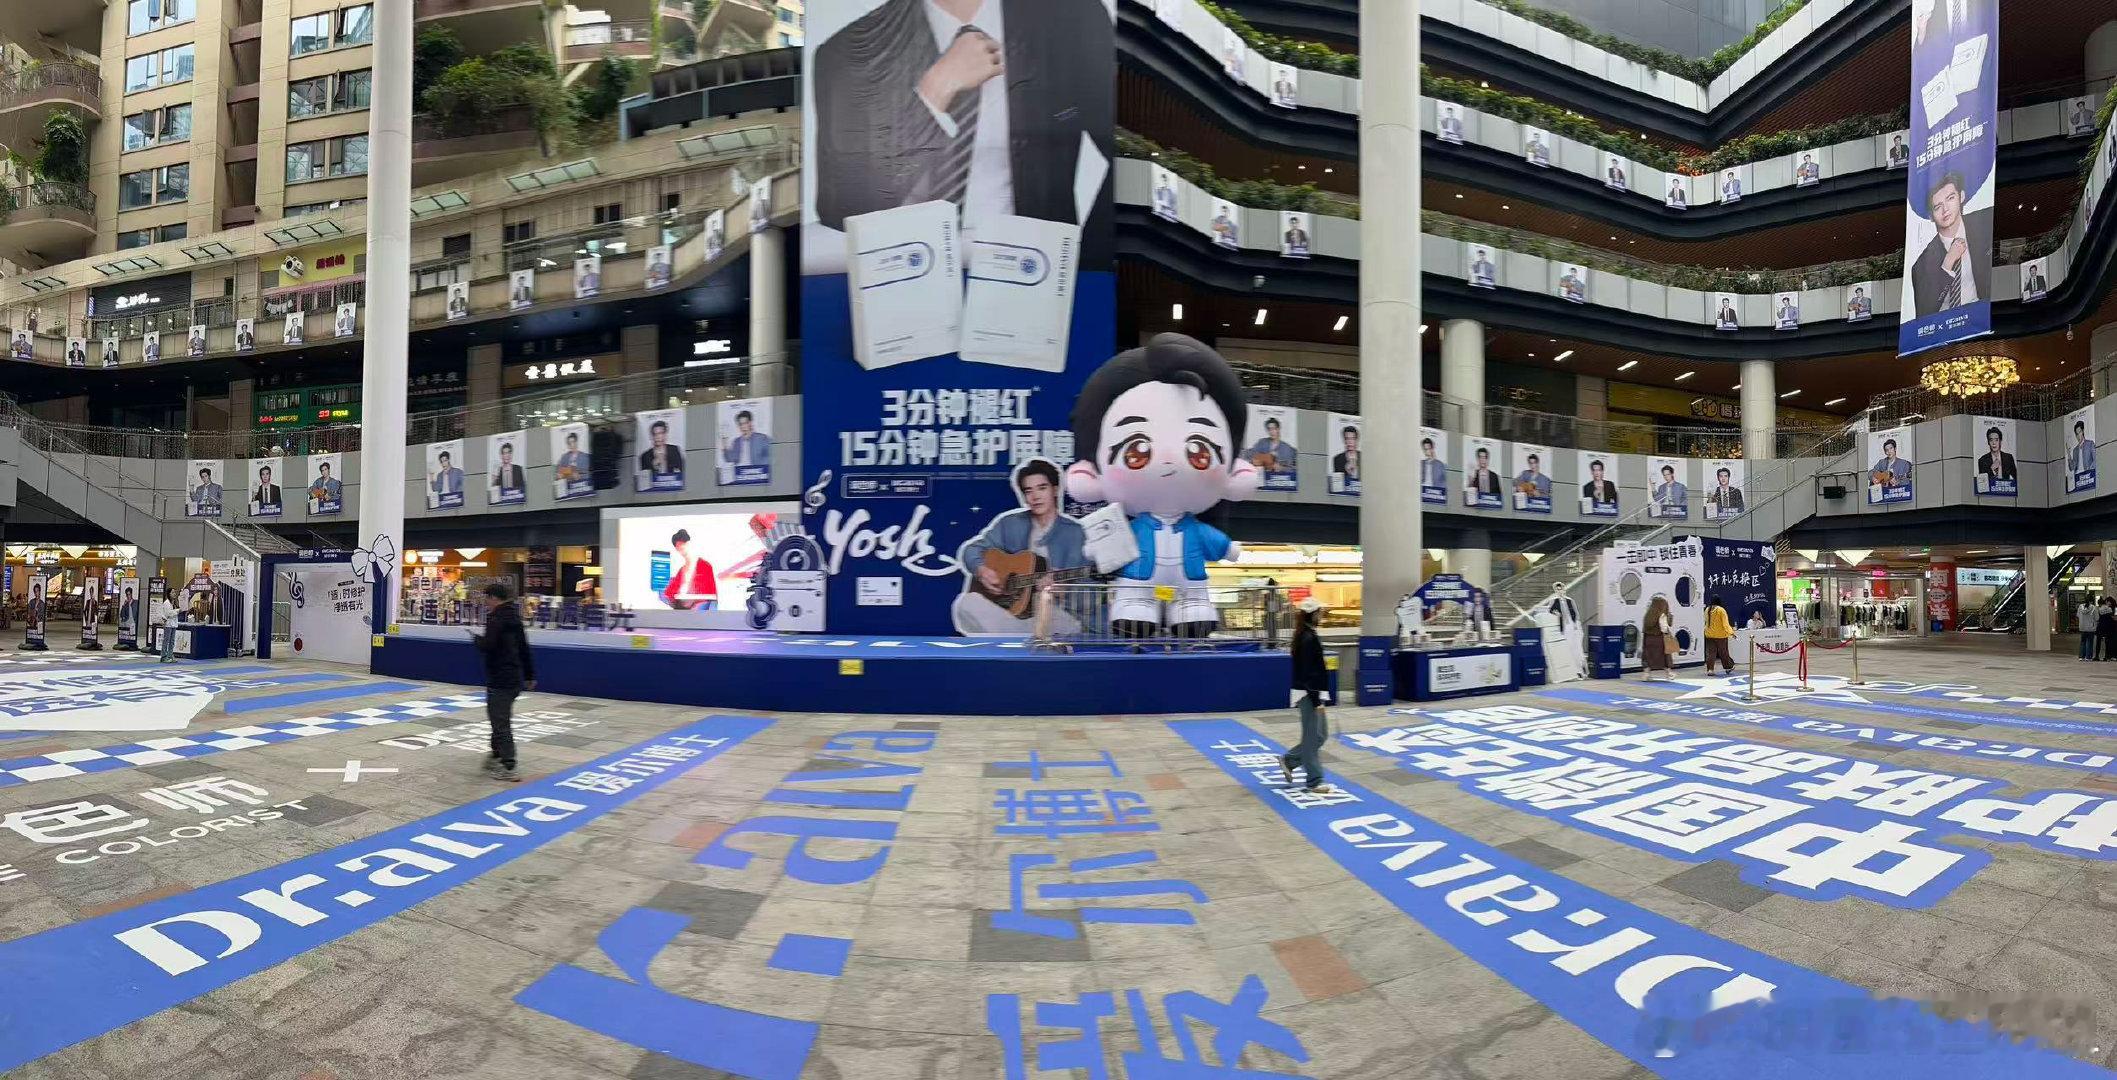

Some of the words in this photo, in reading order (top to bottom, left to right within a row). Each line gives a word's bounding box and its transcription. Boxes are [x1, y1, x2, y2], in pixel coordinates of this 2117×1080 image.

[822, 504, 942, 576] Yosh
[55, 799, 309, 864] COLORIST
[1345, 724, 1967, 898] 中国微生态
